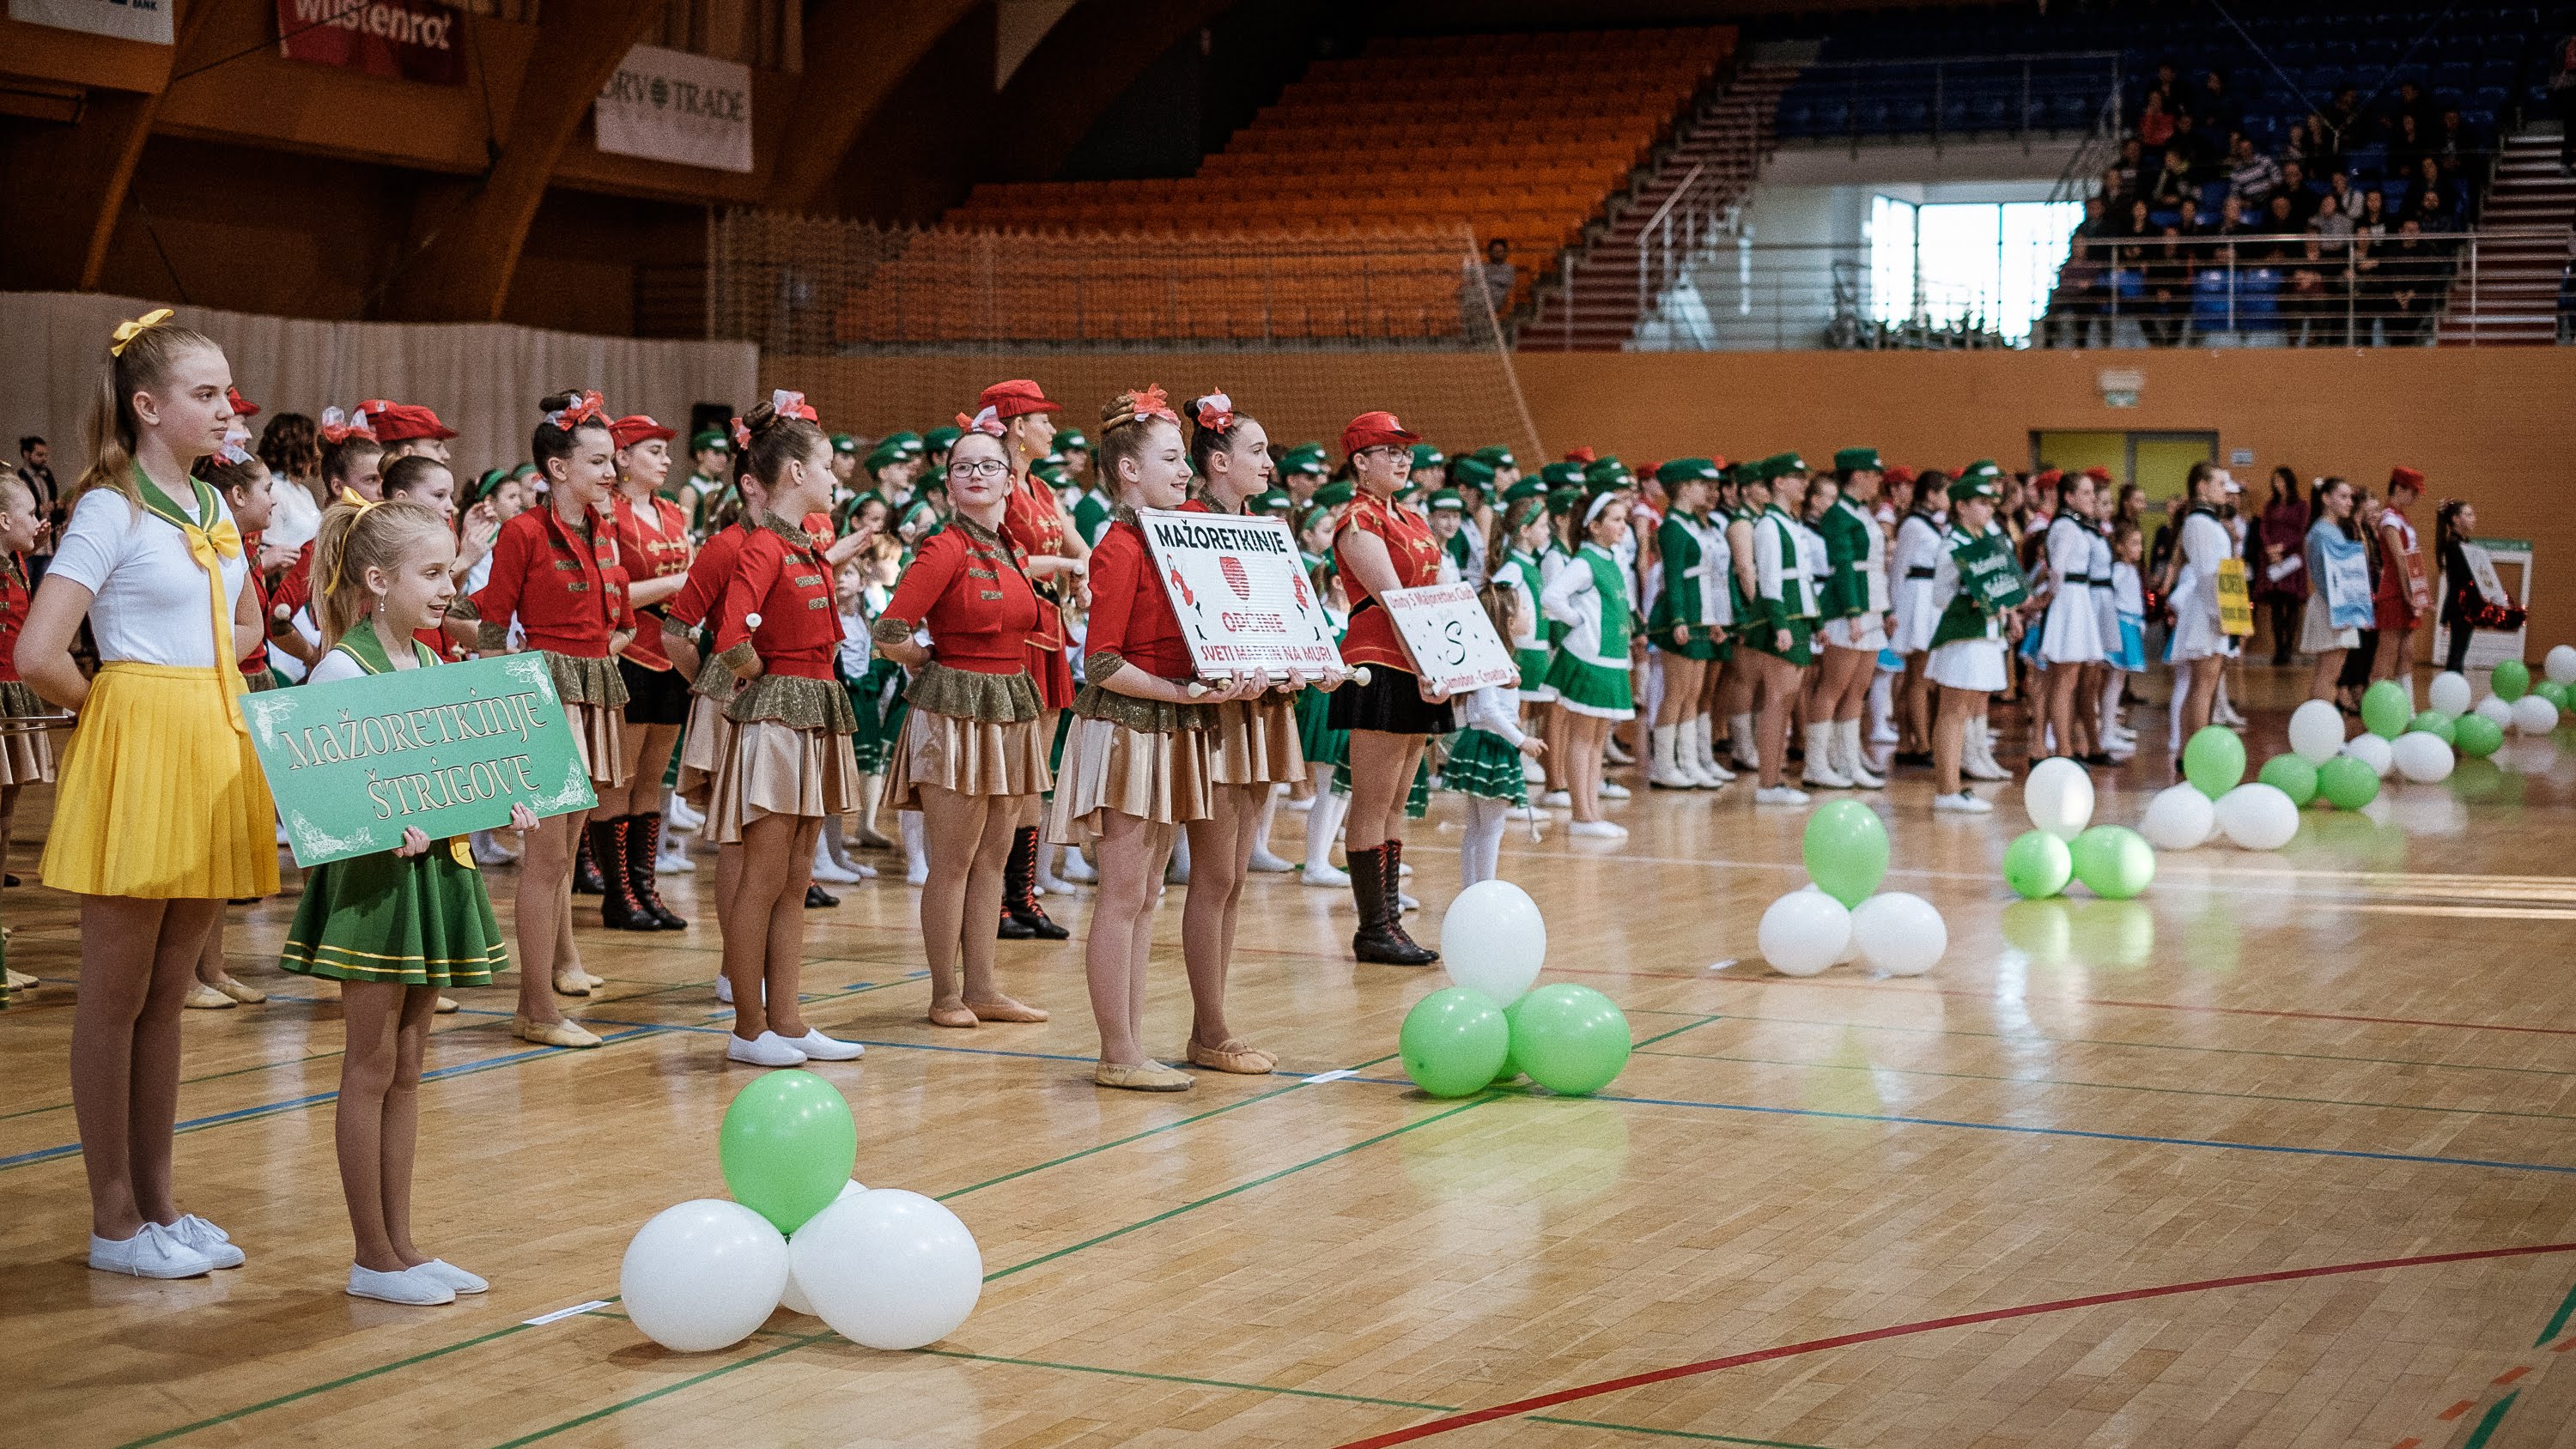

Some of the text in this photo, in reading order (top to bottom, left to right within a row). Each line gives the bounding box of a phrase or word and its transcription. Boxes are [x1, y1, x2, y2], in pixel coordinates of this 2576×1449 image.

[1155, 519, 1287, 555] MAŽORETKINJE
[1455, 587, 1474, 600] Club
[1201, 645, 1236, 661] SVETI
[1284, 646, 1302, 661] NA
[1302, 646, 1333, 661] MURI
[1444, 620, 1467, 666] S
